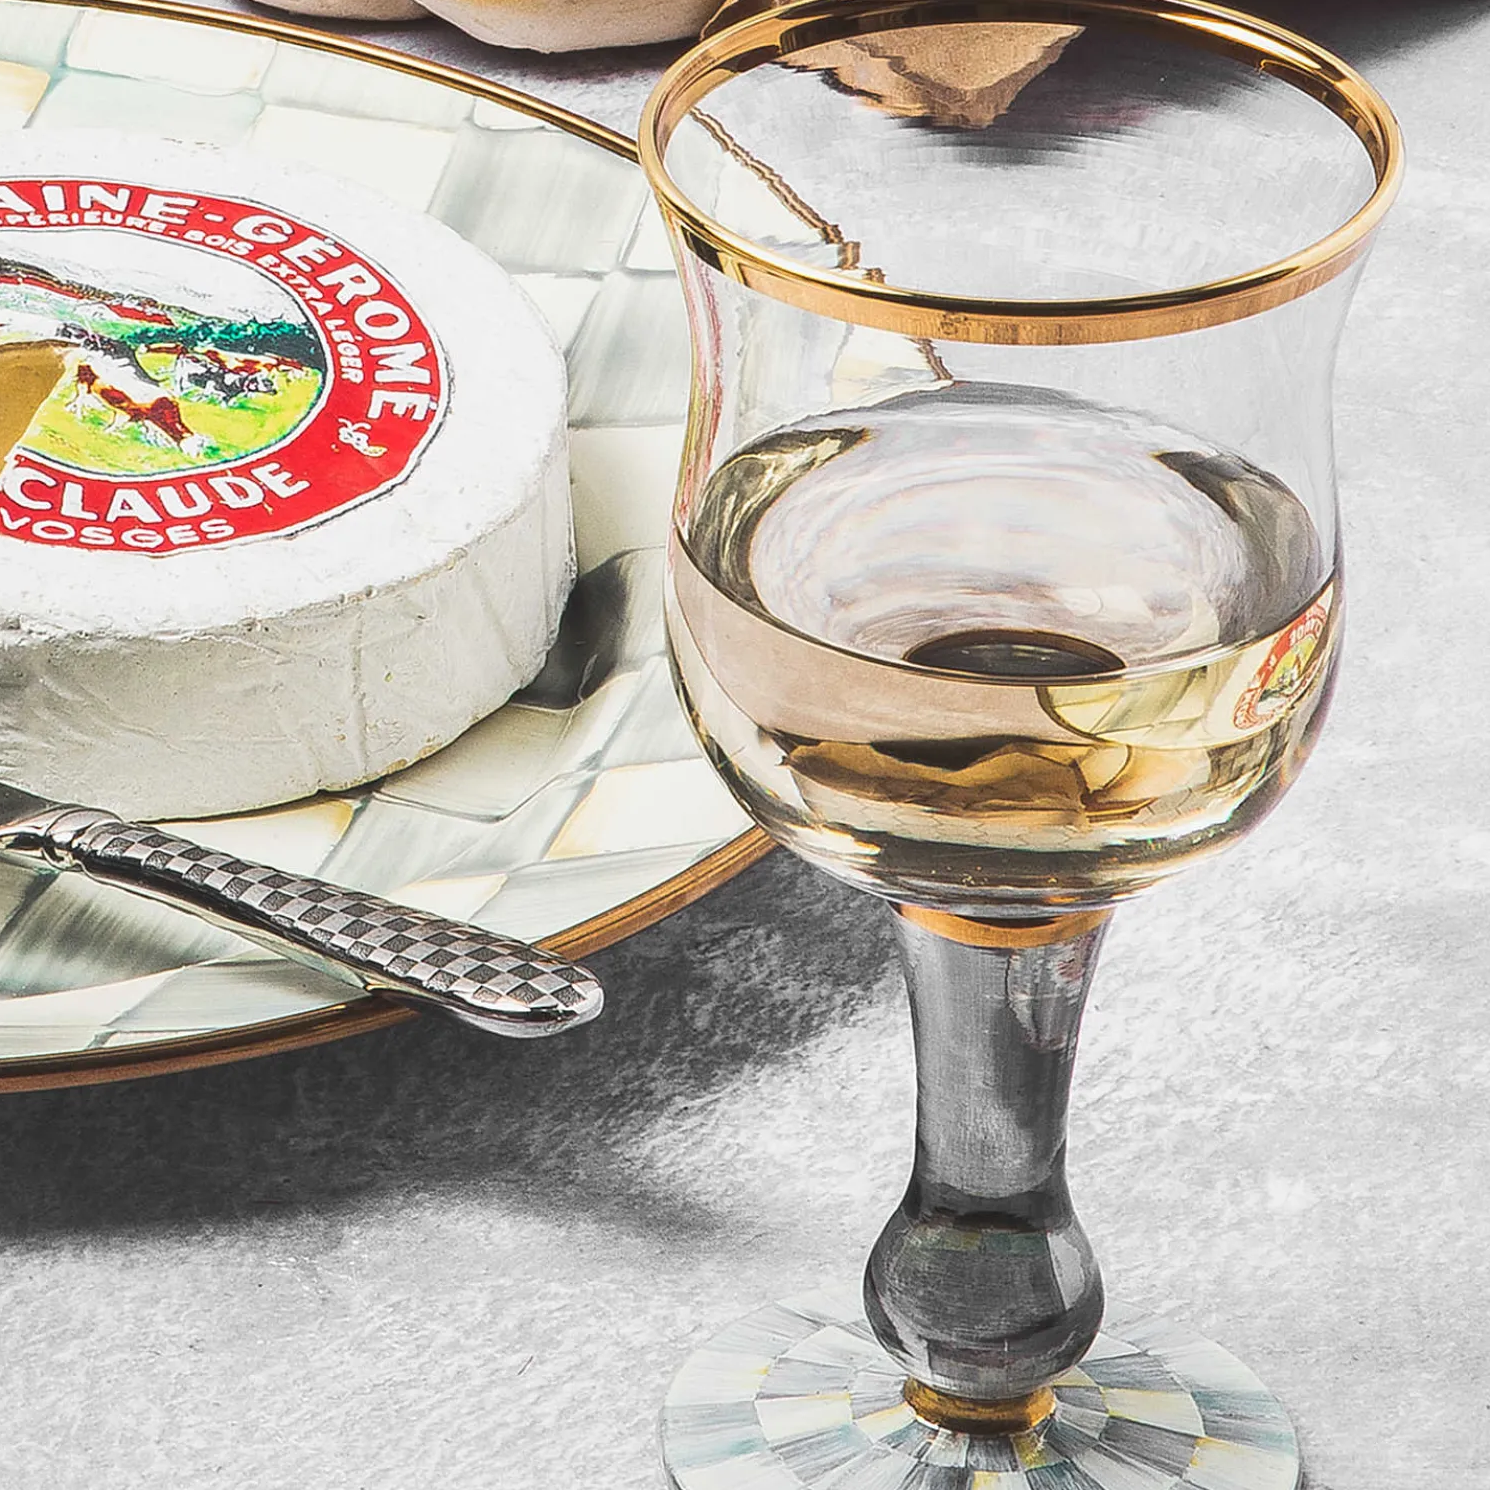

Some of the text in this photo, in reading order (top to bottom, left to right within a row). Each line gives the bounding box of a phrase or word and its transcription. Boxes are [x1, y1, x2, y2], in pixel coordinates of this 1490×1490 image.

[255, 253, 334, 317] EXTRA
[324, 318, 364, 384] LÉGER
[1, 462, 310, 525] CLAUDE
[0, 507, 235, 549] VOSGES
